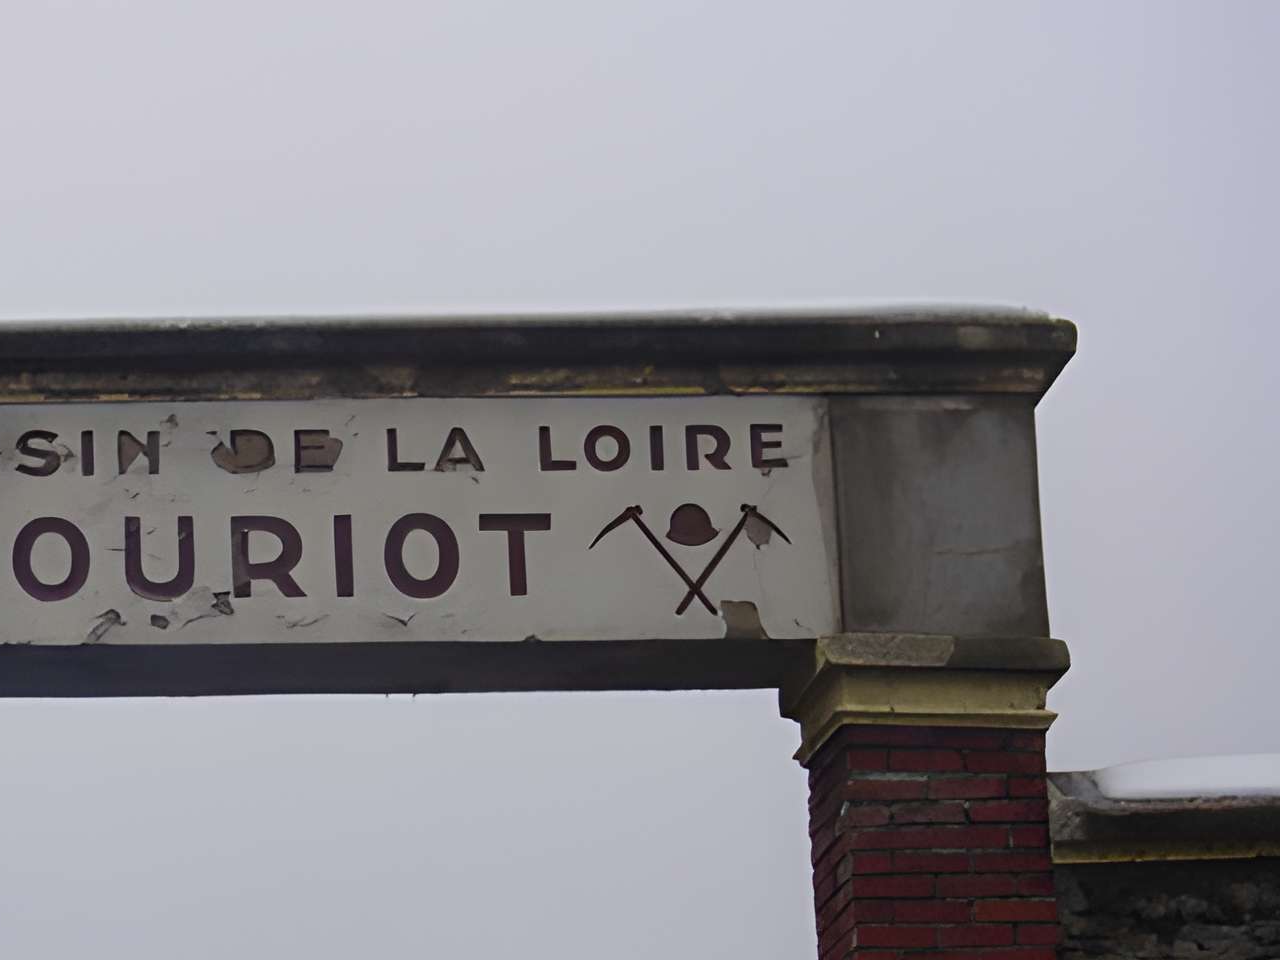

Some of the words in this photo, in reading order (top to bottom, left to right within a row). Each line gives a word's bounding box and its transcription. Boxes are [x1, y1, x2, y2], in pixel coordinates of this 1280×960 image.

[210, 429, 344, 474] DE
[386, 427, 485, 472] LA
[538, 423, 789, 472] LOIRE
